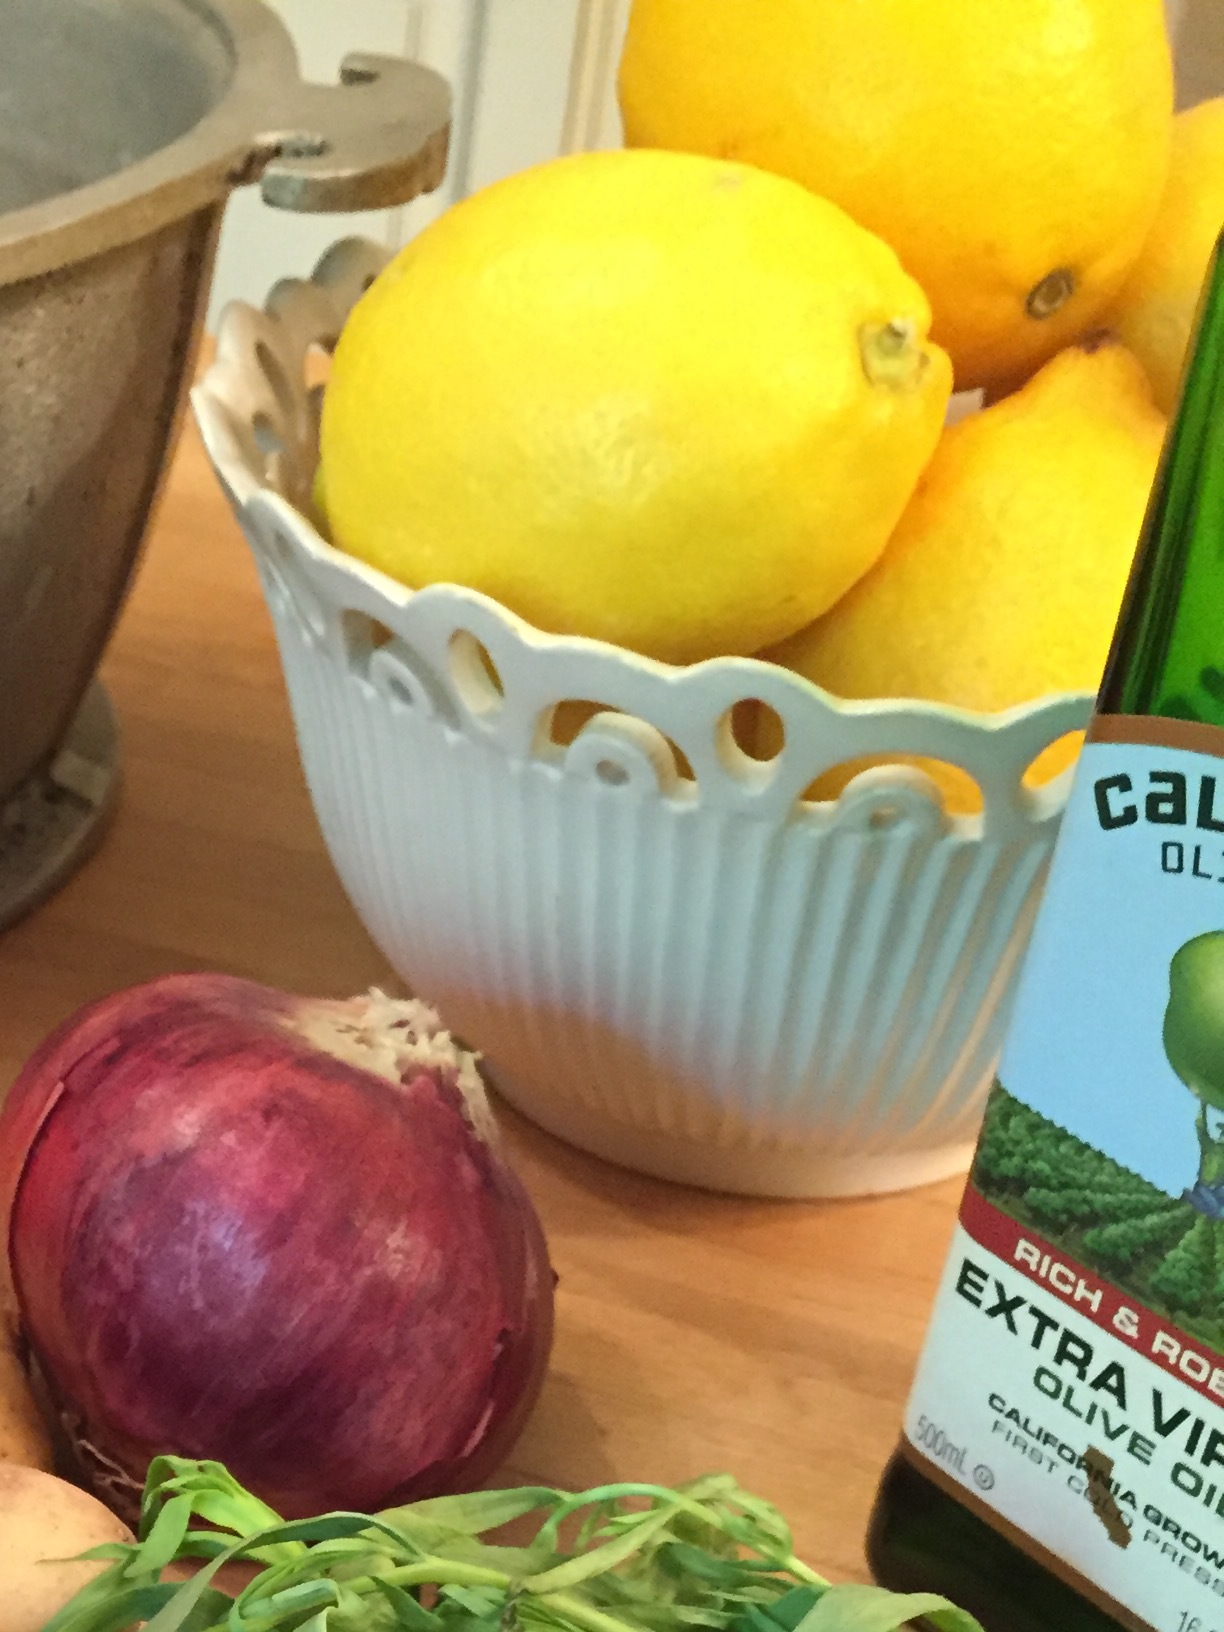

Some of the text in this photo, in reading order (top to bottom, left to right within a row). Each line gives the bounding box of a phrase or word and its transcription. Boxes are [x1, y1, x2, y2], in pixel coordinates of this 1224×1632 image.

[956, 1257, 1127, 1411] EXTRA
[1014, 1238, 1103, 1313] RICH
[1112, 1305, 1141, 1340] &
[988, 1393, 1137, 1510] CALIFORNIA
[991, 1420, 1059, 1474] FIRST
[1033, 1366, 1157, 1466] OLIVE
